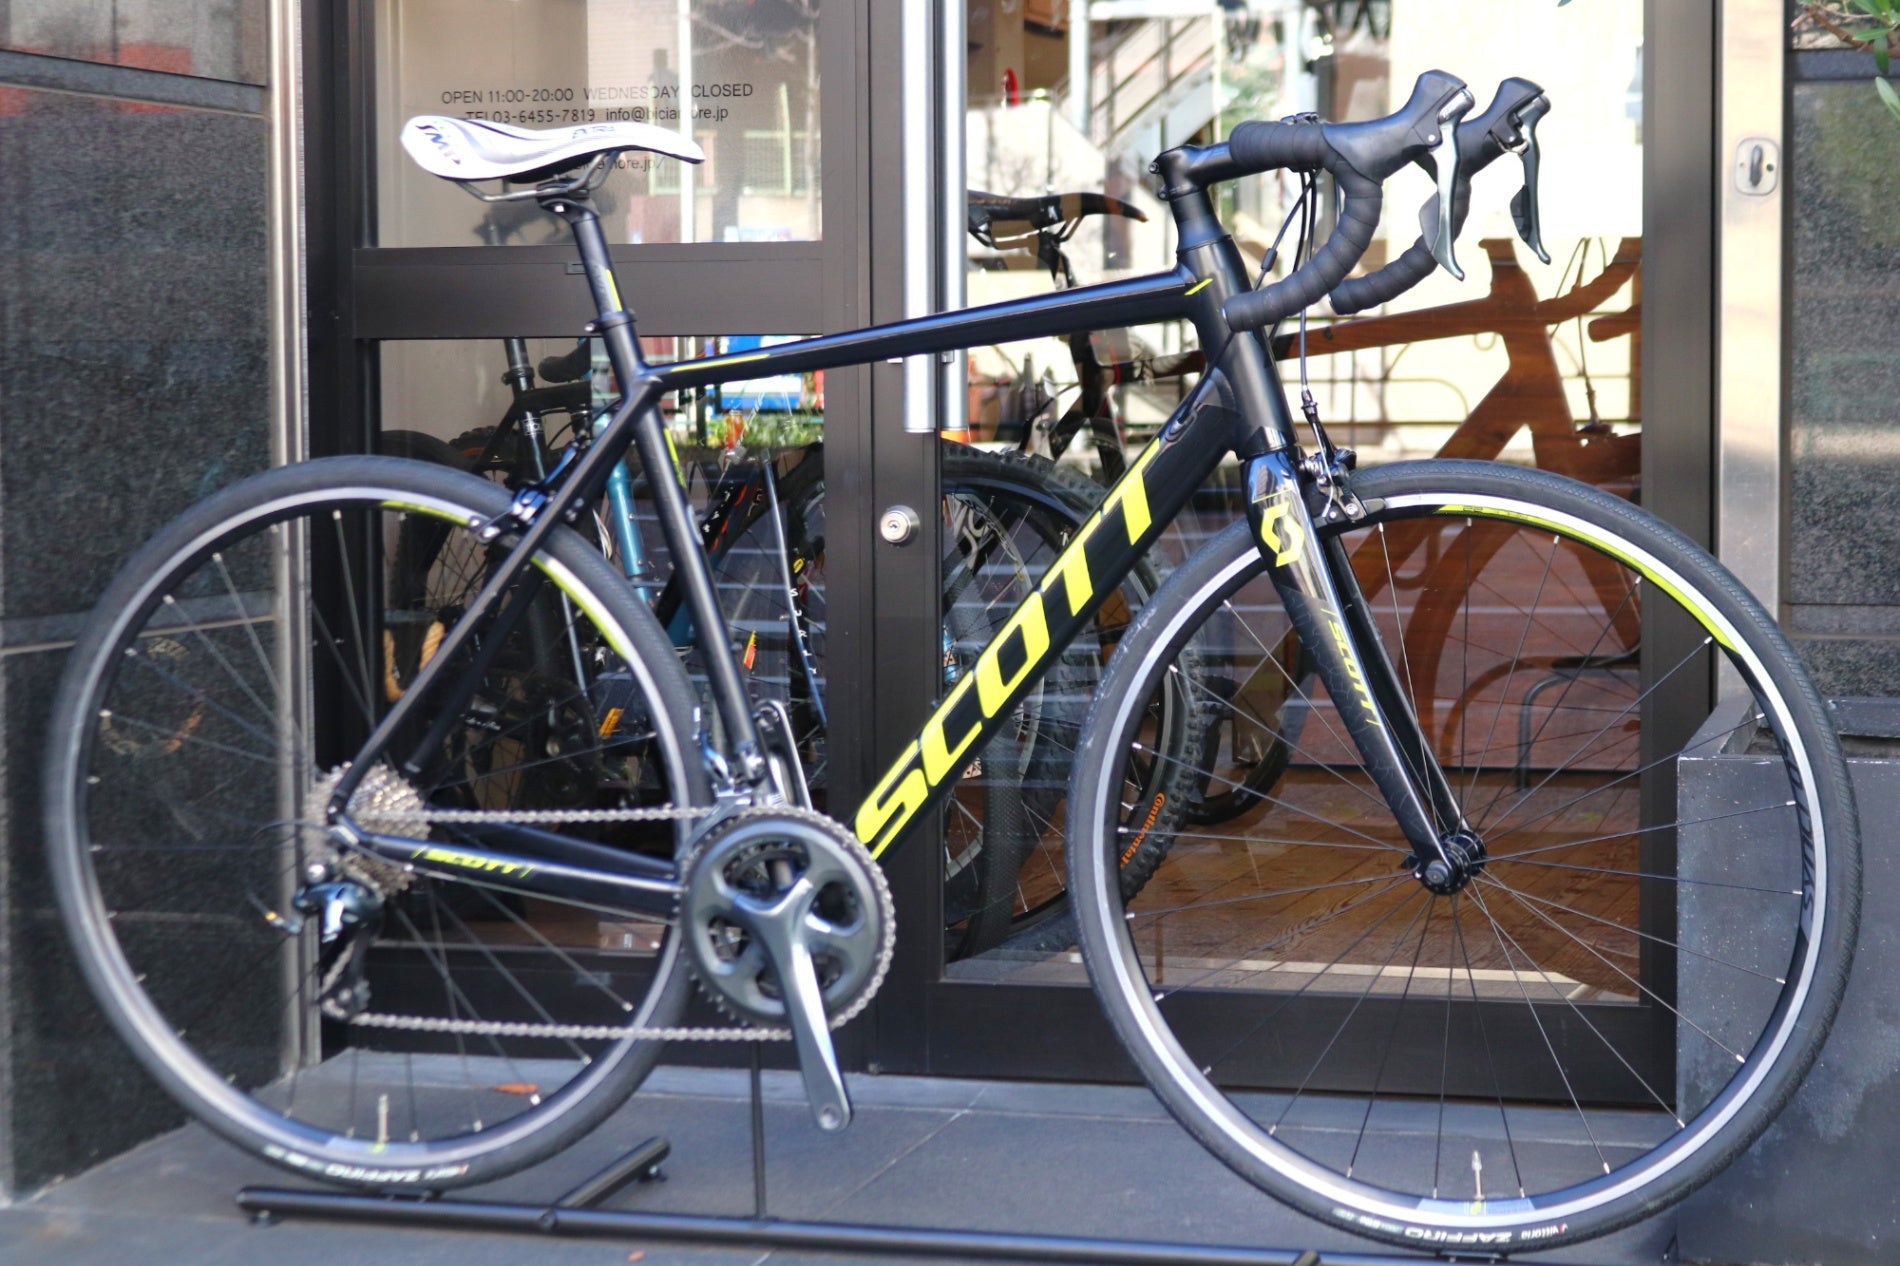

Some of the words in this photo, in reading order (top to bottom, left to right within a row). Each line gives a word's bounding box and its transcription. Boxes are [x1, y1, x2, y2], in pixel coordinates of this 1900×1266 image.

[441, 91, 483, 104] OPEN
[489, 88, 574, 103] 11:00-20:00
[583, 86, 680, 100] WEDNESDAY
[691, 83, 753, 98] CLOSED
[606, 106, 728, 122] info@biciaore.jp
[789, 587, 818, 675] SURLY
[855, 437, 1160, 861] SCOTT
[1327, 619, 1378, 717] SCOTT
[423, 847, 521, 875] SCOTT
[1404, 1225, 1513, 1244] ZAFFIRO
